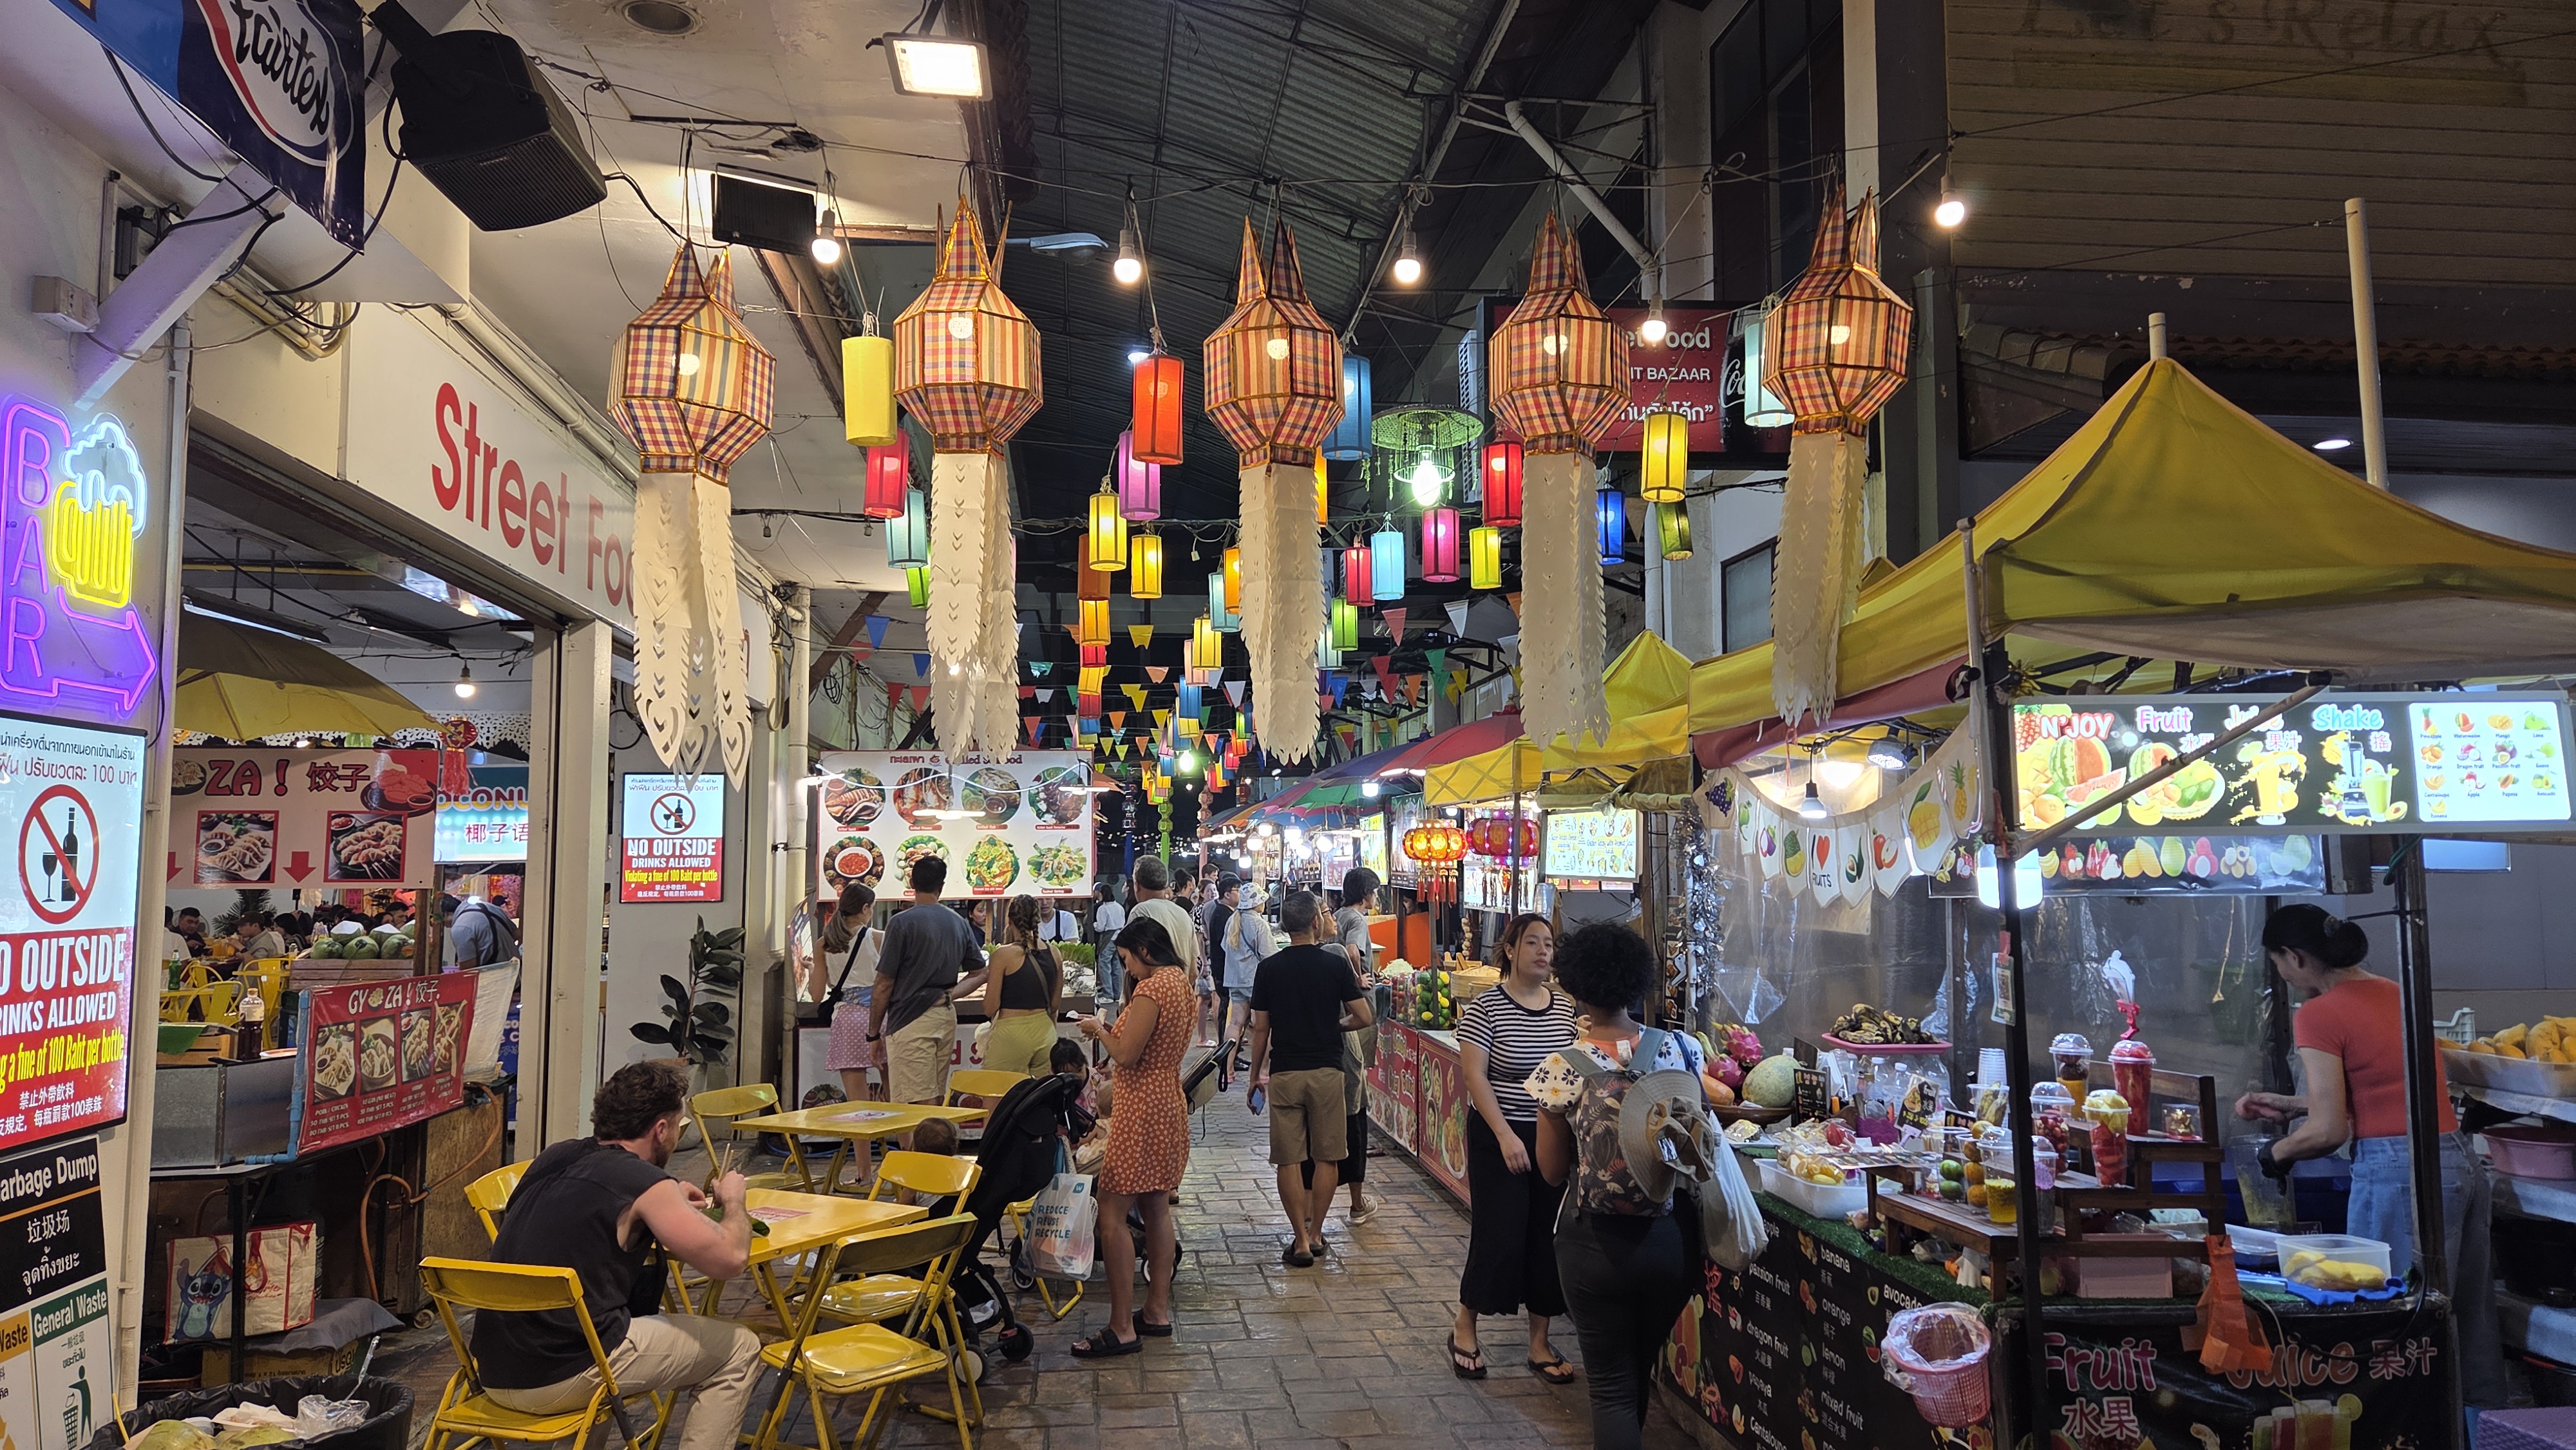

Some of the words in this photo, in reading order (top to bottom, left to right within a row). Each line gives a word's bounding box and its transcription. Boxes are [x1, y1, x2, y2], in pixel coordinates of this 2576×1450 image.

[1652, 327, 1710, 348] ood
[1647, 367, 1710, 381] BAZAAR
[431, 382, 571, 575] Street
[587, 494, 636, 617] Fo
[5, 426, 52, 679] BAR
[2136, 705, 2193, 733] Fruit
[2224, 704, 2285, 732] Jue
[2313, 704, 2384, 731] Shake
[2266, 731, 2303, 751] 果汁
[93, 764, 115, 784] 100
[306, 762, 371, 793] 饺子
[627, 839, 649, 856] NO
[653, 839, 717, 856] OUTSIDE
[632, 858, 667, 868] DRINKS
[668, 857, 711, 868] ALLOWED
[21, 934, 127, 993] OUTSIDE
[47, 992, 117, 1029] ALLOWED
[8, 1053, 15, 1083] a
[17, 1042, 35, 1082] fine
[37, 1039, 47, 1077] of
[48, 1035, 65, 1074] 100
[65, 1033, 86, 1071] Baht
[85, 1037, 100, 1075] per
[101, 1026, 124, 1064] bottle
[0, 1169, 52, 1202] arbage
[56, 1154, 97, 1185] Dump
[26, 1209, 70, 1244] 垃圾场
[1035, 1228, 1071, 1239] RECYCLE
[1036, 1216, 1059, 1227] REUSE
[22, 1245, 80, 1295] จุดทิ้งขยะ
[1821, 1245, 1851, 1274] banana
[1749, 1263, 1774, 1287] passion
[1776, 1274, 1790, 1295] fruit
[33, 1298, 75, 1339] General
[76, 1289, 107, 1319] Waste
[1822, 1298, 1851, 1327] orange
[1747, 1320, 1772, 1347] dragon
[1774, 1336, 1788, 1359] fruit
[1822, 1342, 1846, 1371] lemon
[2044, 1332, 2157, 1392] Fruit
[2369, 1336, 2439, 1380] 果汁
[1821, 1390, 1844, 1417] mixed
[1846, 1404, 1864, 1431] fruit
[2061, 1396, 2141, 1440] 水果
